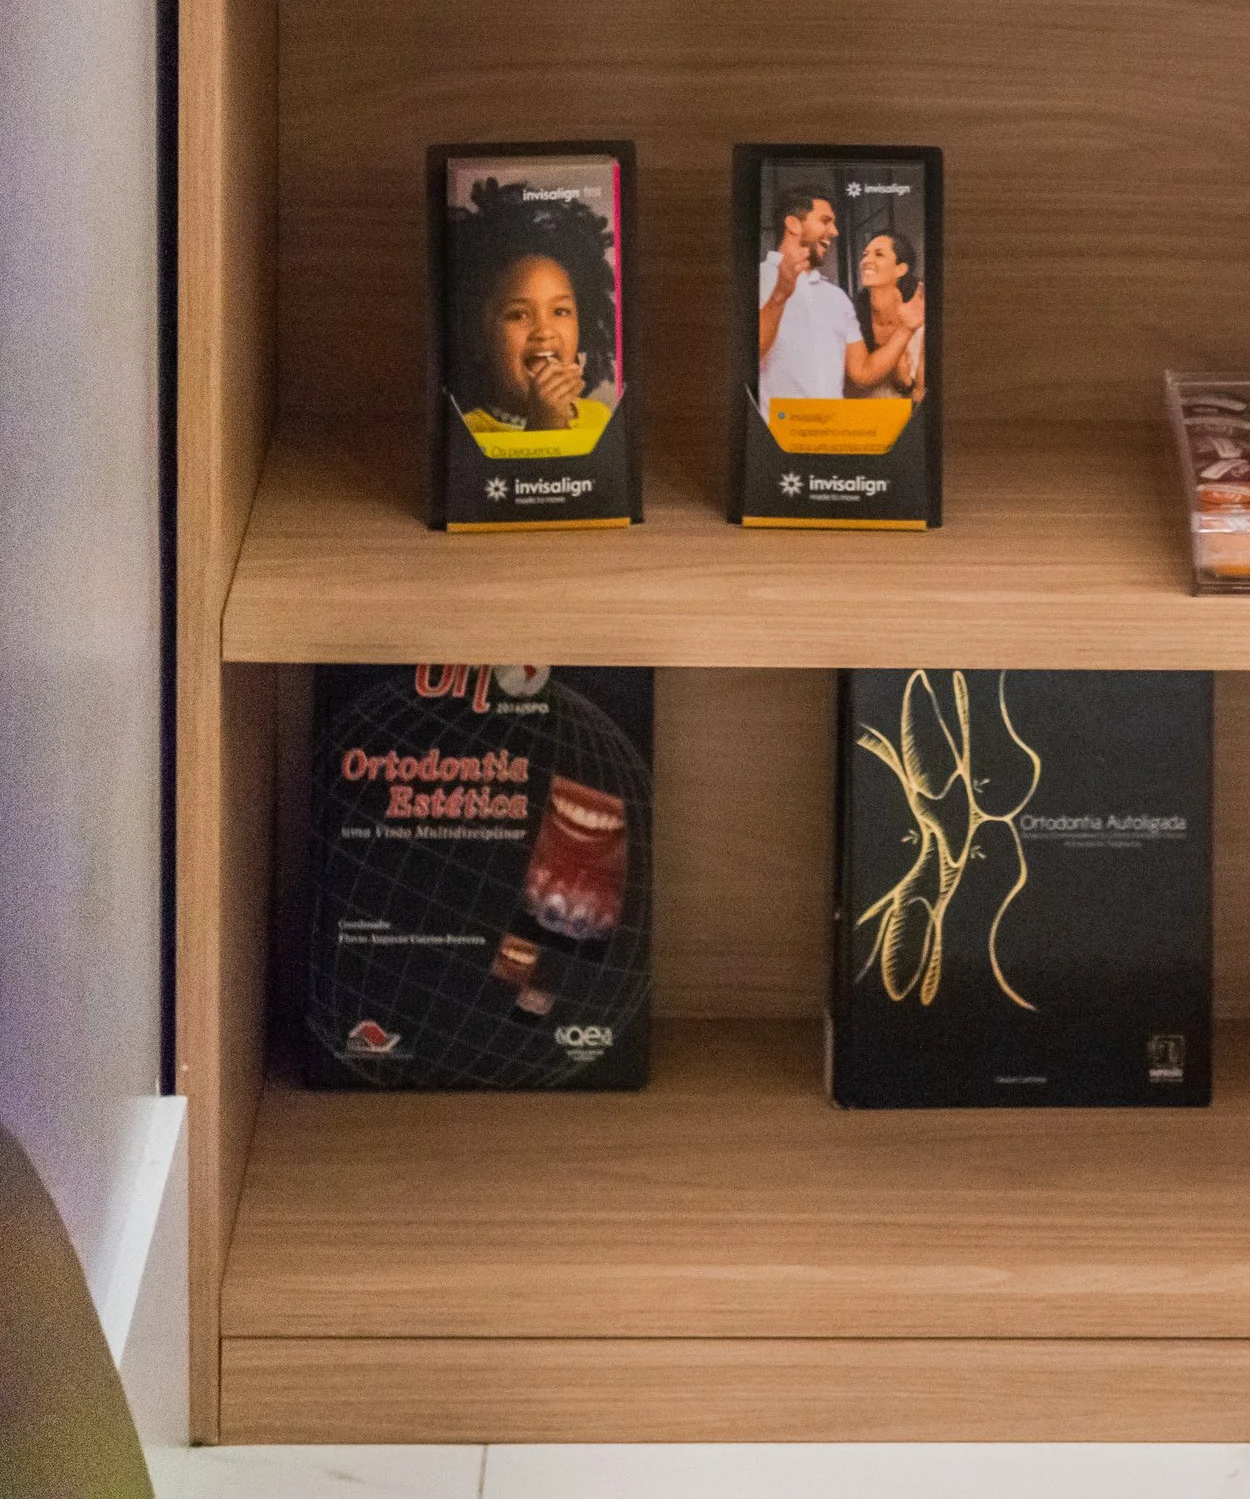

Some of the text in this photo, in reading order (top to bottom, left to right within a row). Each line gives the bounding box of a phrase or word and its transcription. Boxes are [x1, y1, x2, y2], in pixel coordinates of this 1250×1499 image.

[523, 186, 580, 202] invisalign
[515, 477, 593, 497] invisalign
[809, 474, 887, 496] invisalign
[342, 747, 529, 782] Ortodontia
[385, 785, 529, 819] Estética
[1021, 814, 1188, 834] Ortodontia Autoligada
